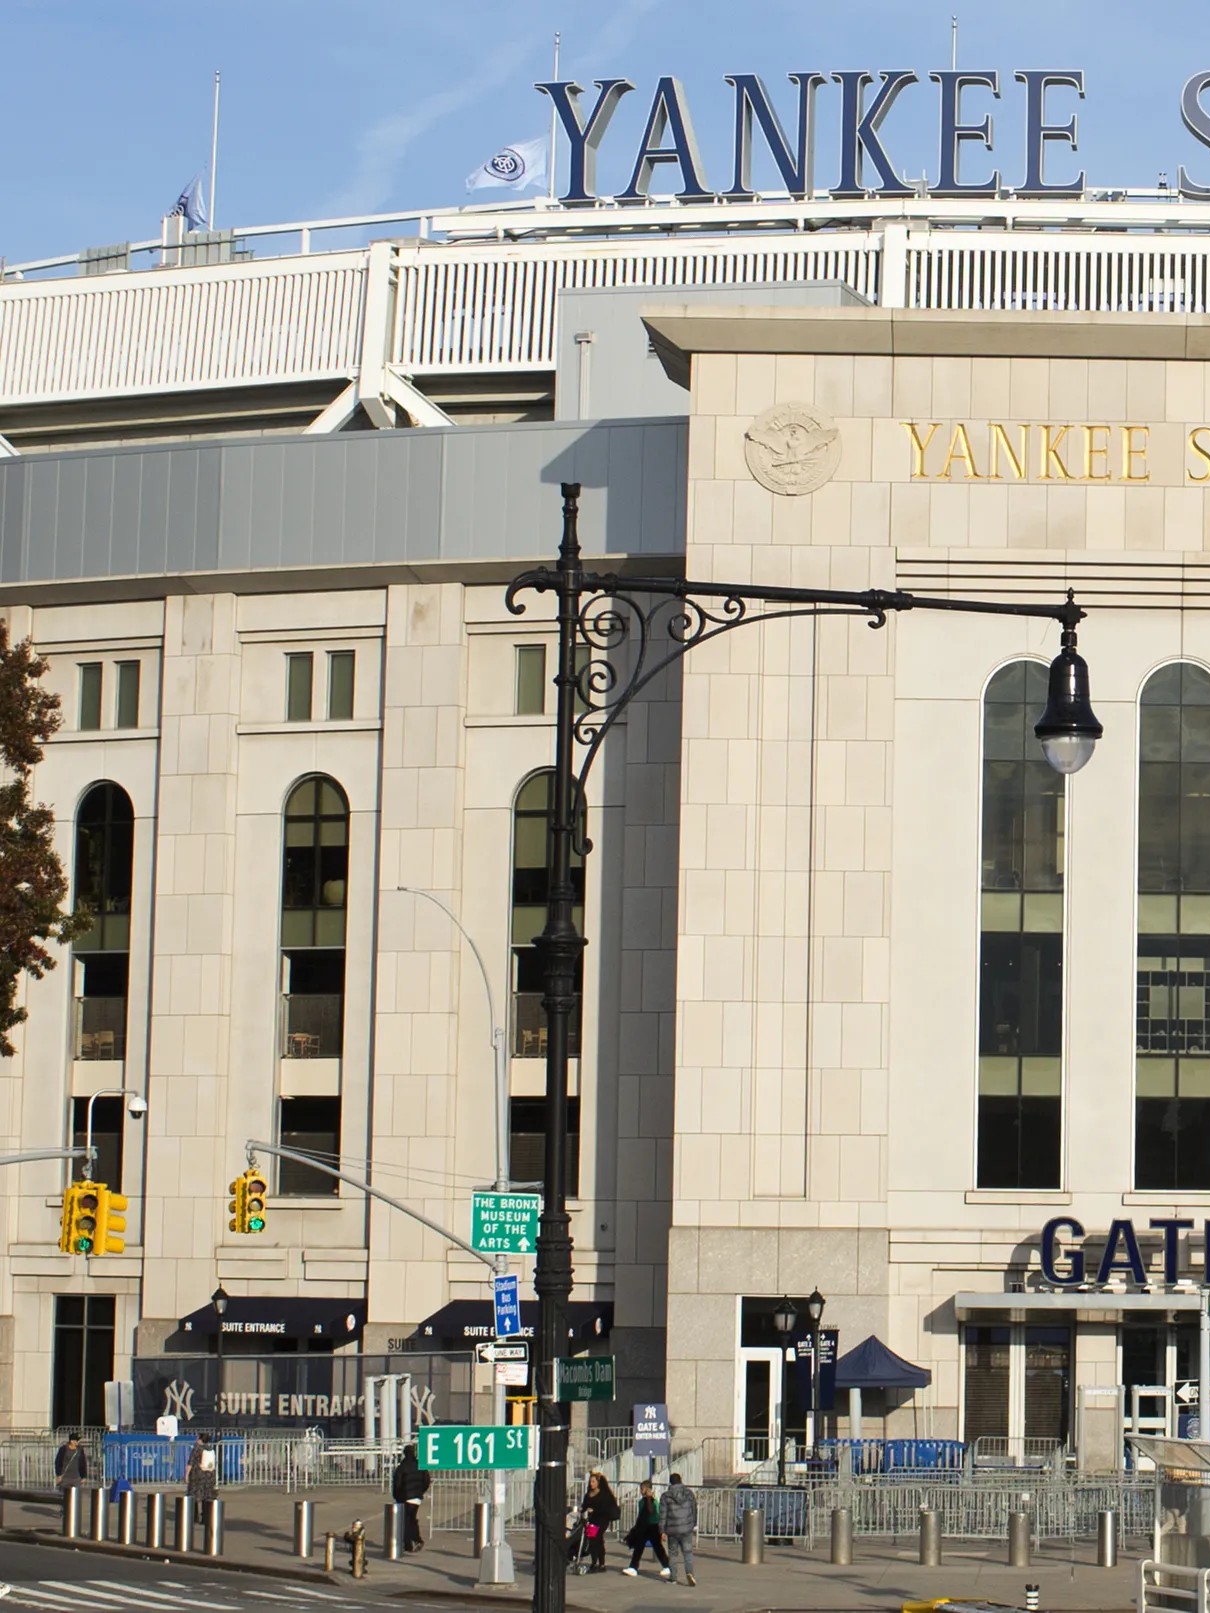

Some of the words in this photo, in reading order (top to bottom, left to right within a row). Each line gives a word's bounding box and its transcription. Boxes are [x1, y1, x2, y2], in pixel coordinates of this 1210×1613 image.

[533, 69, 1087, 204] YANKEE
[899, 422, 1151, 481] YANKEE
[474, 1197, 495, 1208] THE
[500, 1198, 538, 1210] BRONX
[481, 1210, 530, 1222] MUSEUM
[483, 1223, 499, 1234] OF
[504, 1224, 527, 1235] THE
[479, 1237, 510, 1249] ARTS
[495, 1280, 516, 1292] Stadium
[501, 1293, 511, 1303] Bus
[497, 1304, 517, 1317] Parking
[221, 1321, 243, 1332] SUITE
[245, 1322, 286, 1333] ENTRANCE
[464, 1326, 488, 1337] SUITE
[509, 1347, 523, 1356] WAY
[559, 1361, 593, 1383] Macombs
[594, 1360, 612, 1382] Dam
[214, 1391, 272, 1416] SUITE
[637, 1422, 658, 1432] GATE
[658, 1422, 665, 1431] 4
[427, 1432, 440, 1465] E
[453, 1432, 495, 1465] 161
[506, 1429, 523, 1449] St
